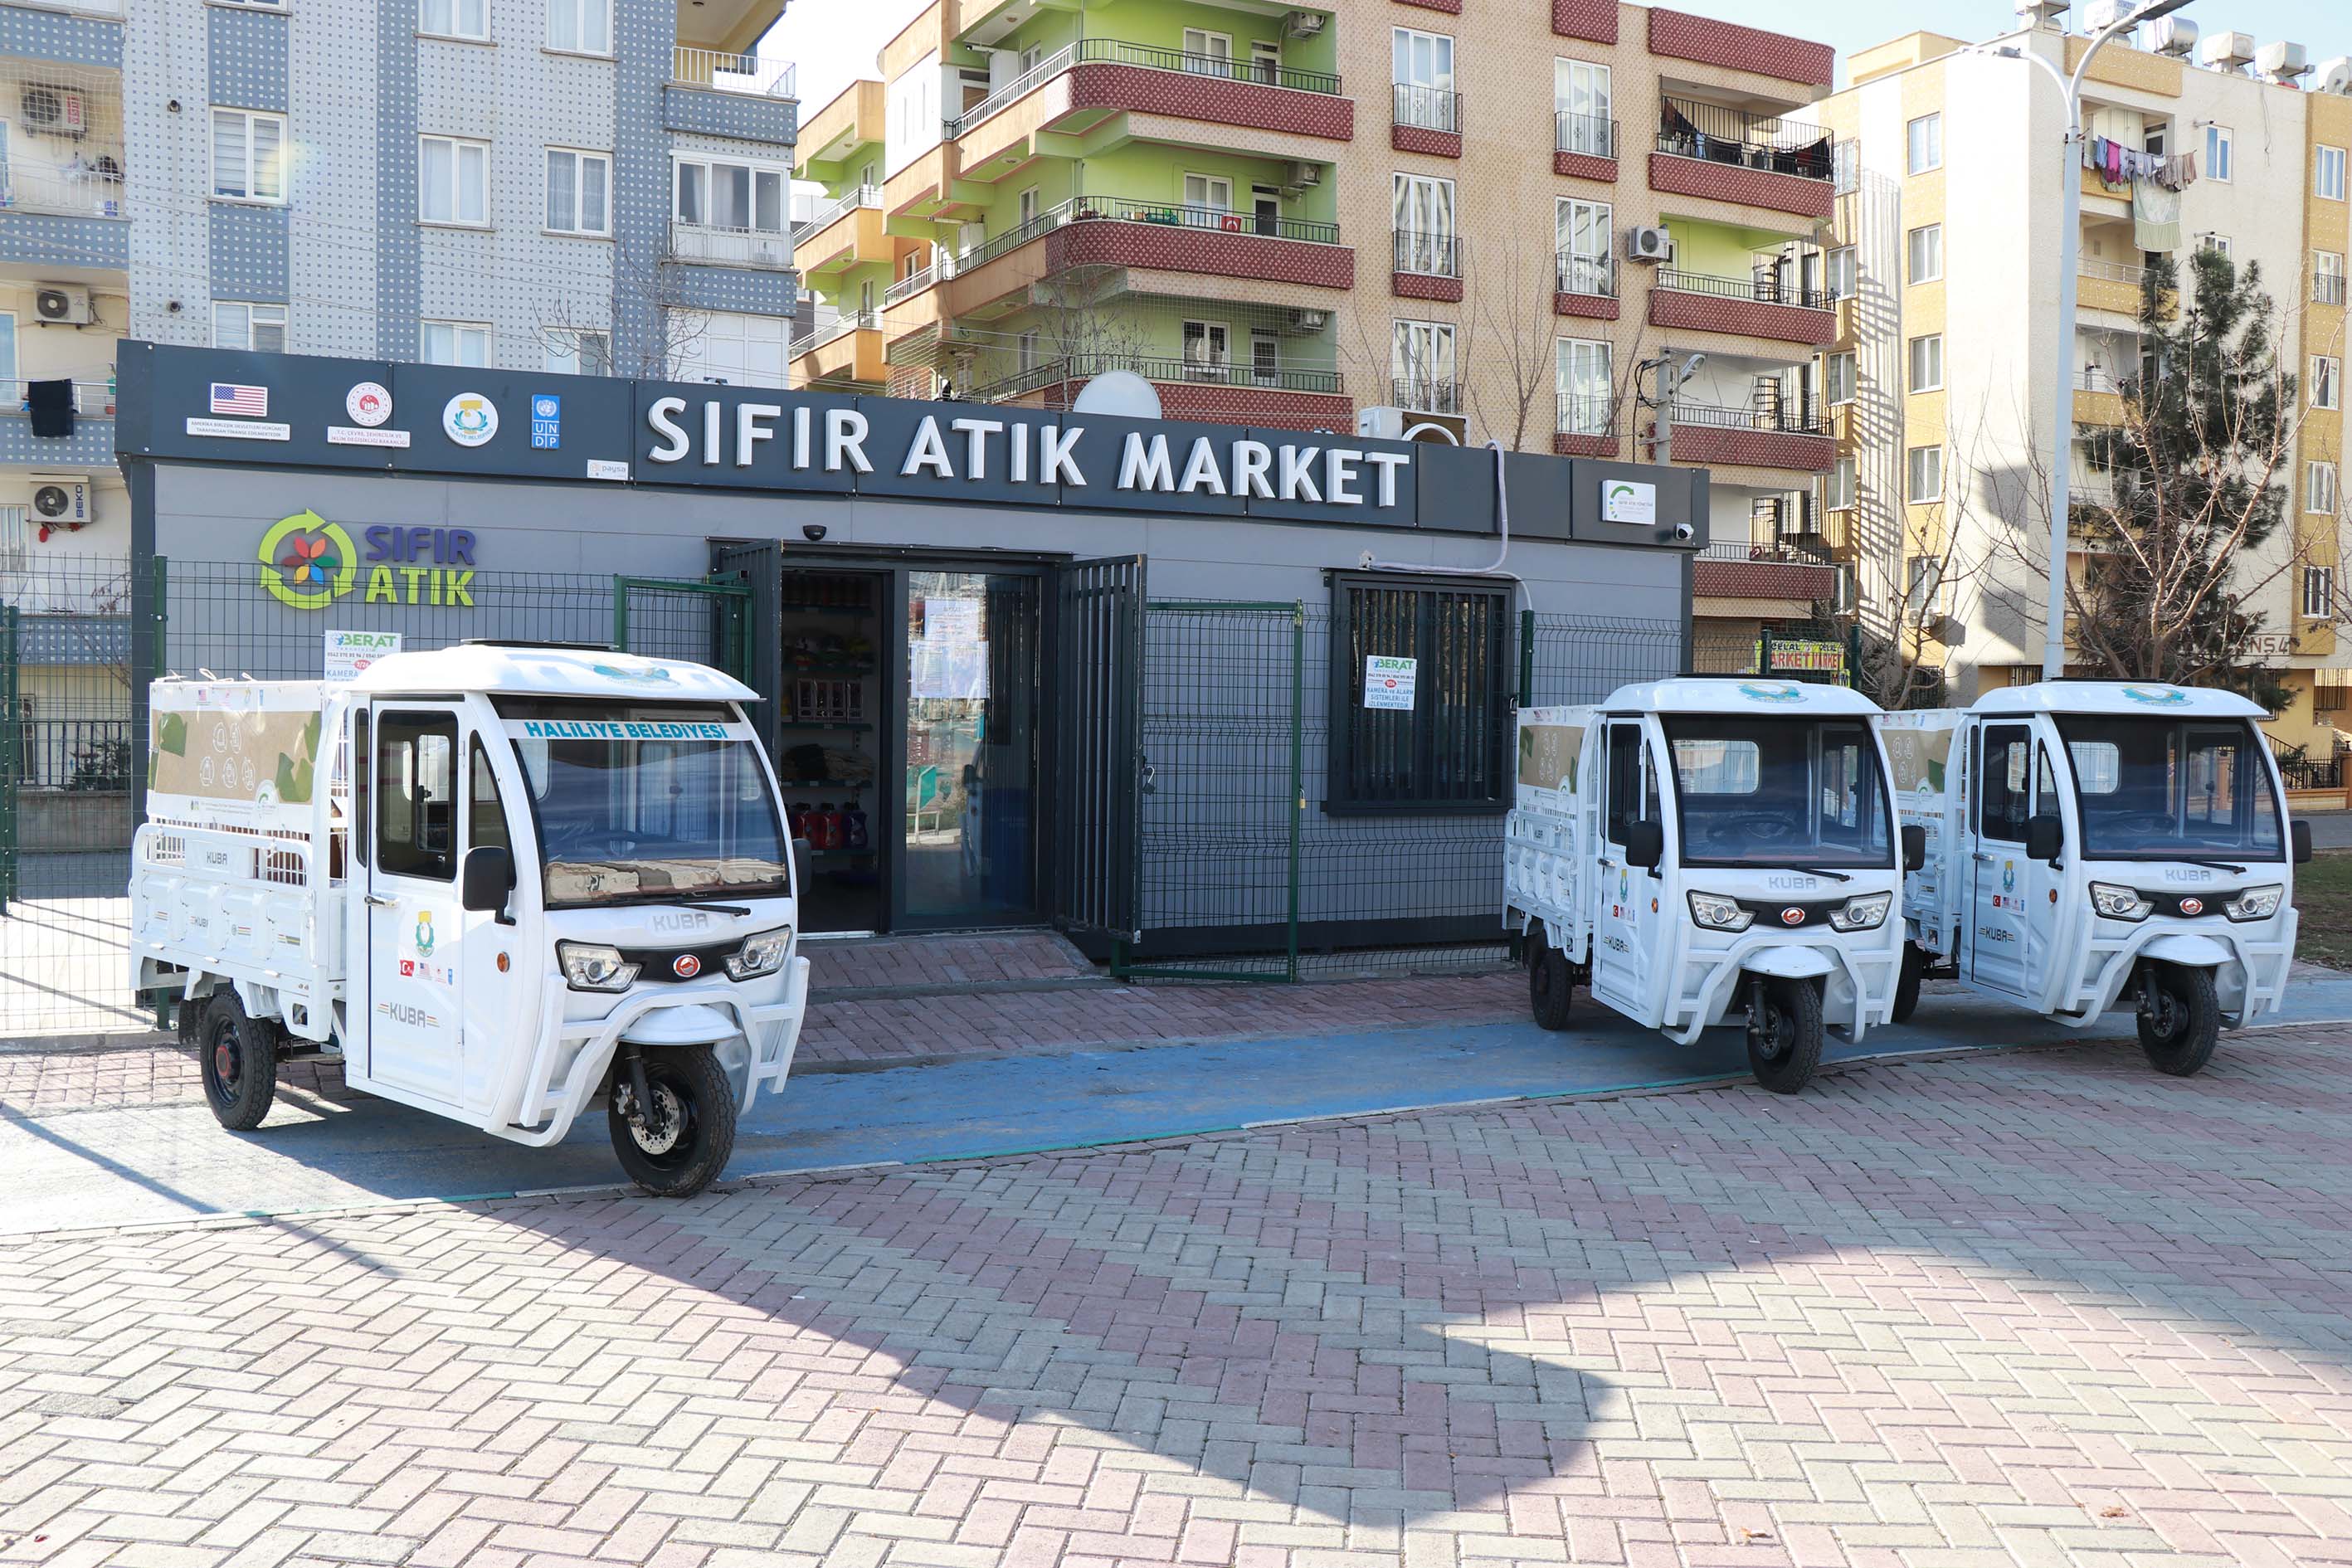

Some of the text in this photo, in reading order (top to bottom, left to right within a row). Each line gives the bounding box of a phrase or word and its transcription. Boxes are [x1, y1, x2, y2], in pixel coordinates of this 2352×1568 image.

[647, 397, 1410, 508] SIFIR ATIK MARKET
[75, 485, 84, 518] BEKO
[365, 525, 476, 565] SIFIR
[365, 565, 475, 606] ATIK
[343, 633, 397, 649] BERAT
[1379, 659, 1414, 670] BERAT
[207, 851, 227, 864] KUBA
[1769, 876, 1817, 889] KUBA
[2165, 869, 2211, 881] KUBA
[653, 913, 709, 931] KUBA
[1985, 926, 2007, 942] KUBA
[1609, 936, 1624, 953] KUBA
[390, 1002, 426, 1028] KUBA
